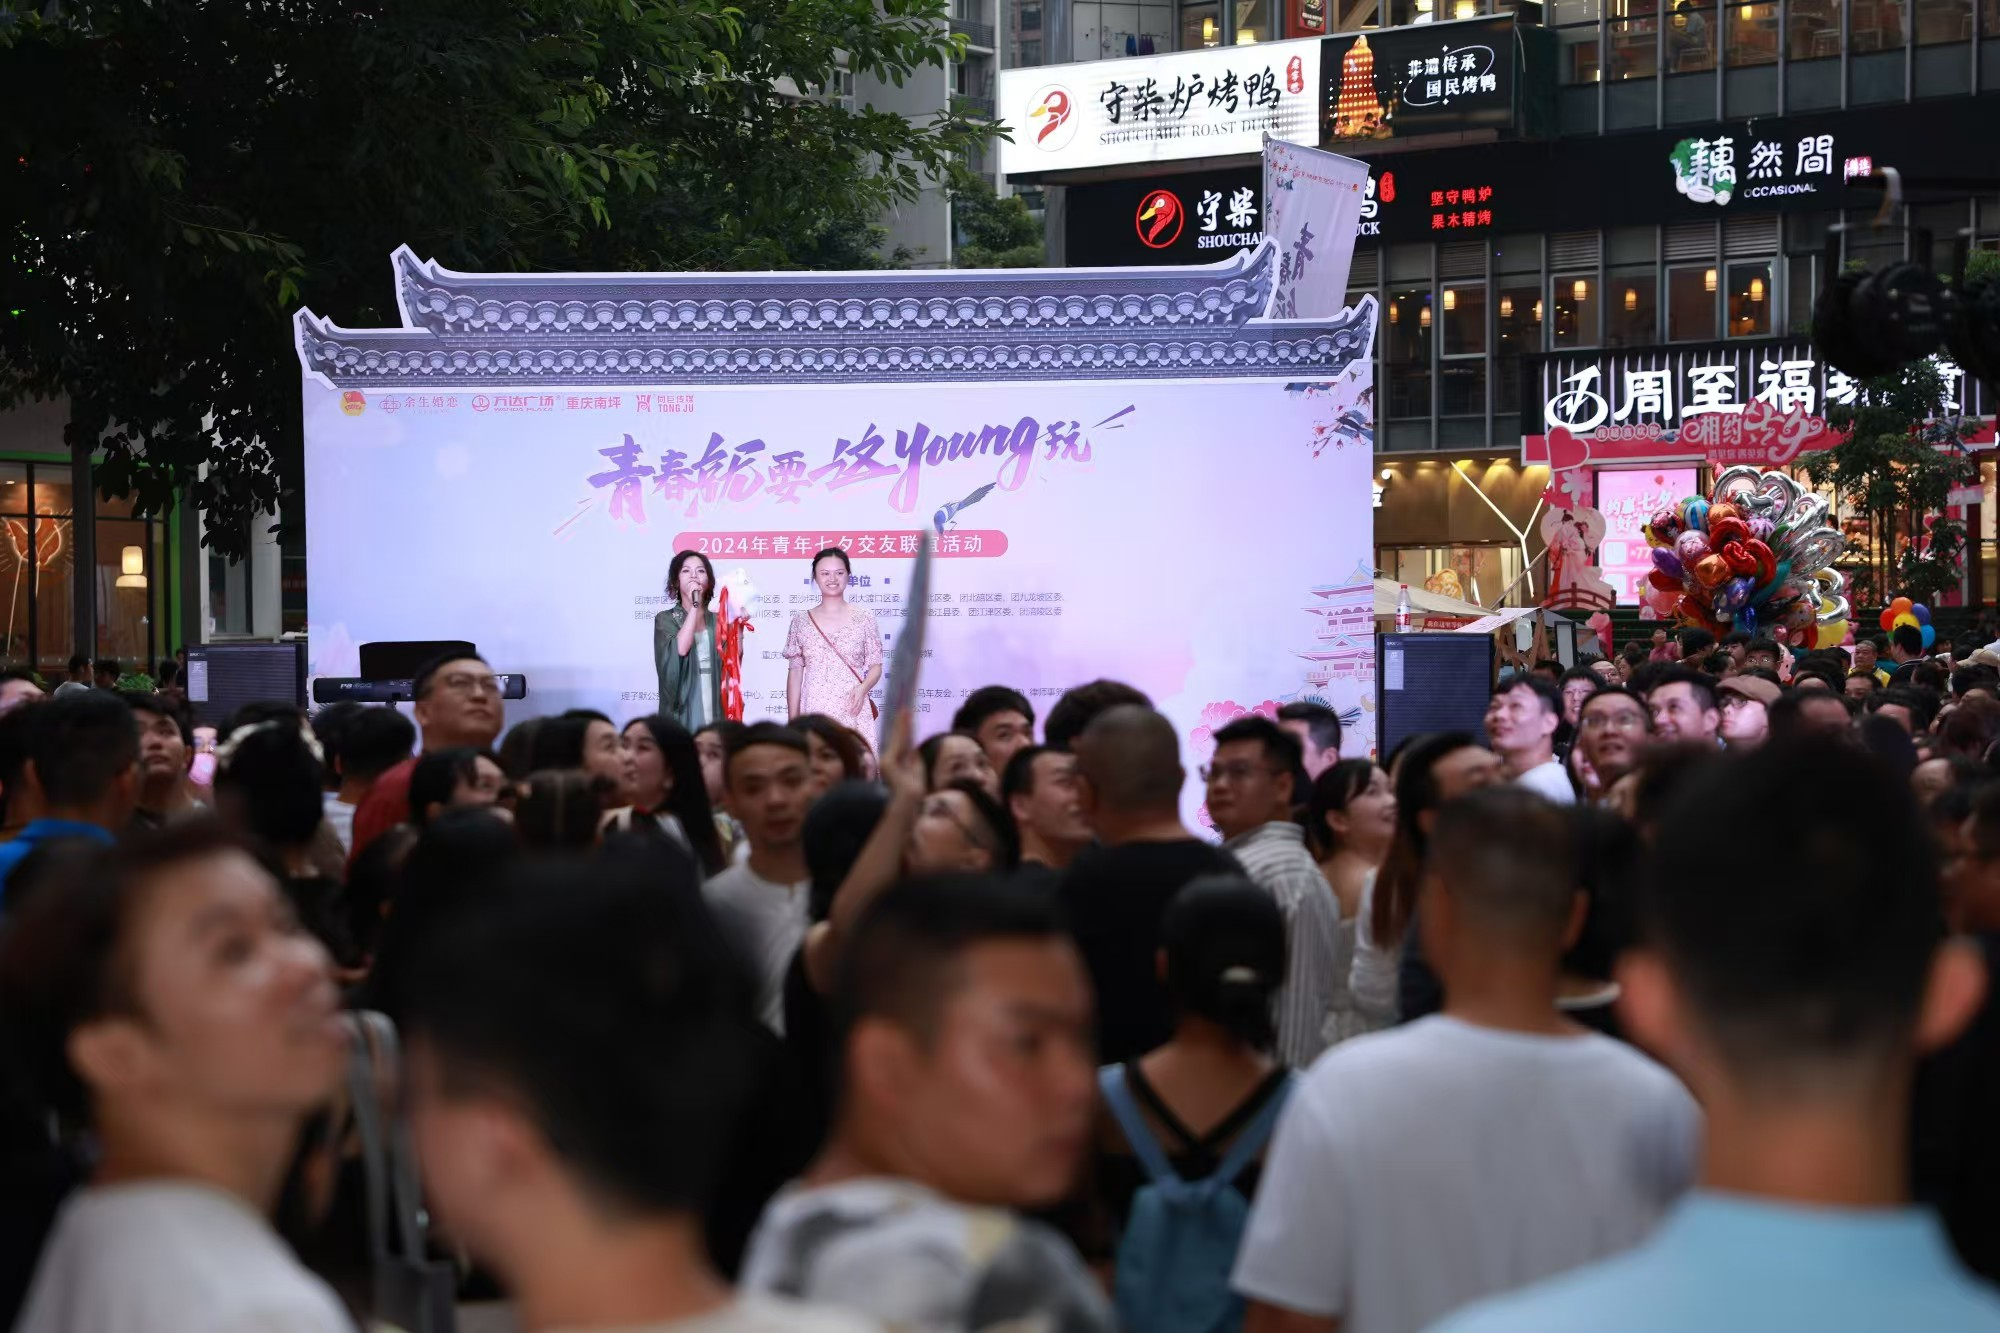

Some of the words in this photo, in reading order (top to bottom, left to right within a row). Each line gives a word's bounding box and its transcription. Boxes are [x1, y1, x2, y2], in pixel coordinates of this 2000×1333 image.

[1408, 53, 1477, 77] 非遗传承
[1100, 65, 1282, 124] 守柴炉烤鸭
[1426, 74, 1497, 98] 国民烤鸭
[1100, 127, 1186, 146] SHOUCHAILU
[1192, 120, 1237, 138] ROAST
[1242, 116, 1281, 133] DUCK
[1430, 186, 1493, 206] 坚守鸭炉
[1743, 183, 1817, 199] OCCASIONAL
[1431, 209, 1492, 229] 果木精烤
[405, 396, 458, 408] 余生婚恋
[493, 395, 554, 407] 万达广场
[566, 396, 622, 410] 重庆南坪
[658, 404, 680, 413] TONG
[682, 404, 694, 413] JU
